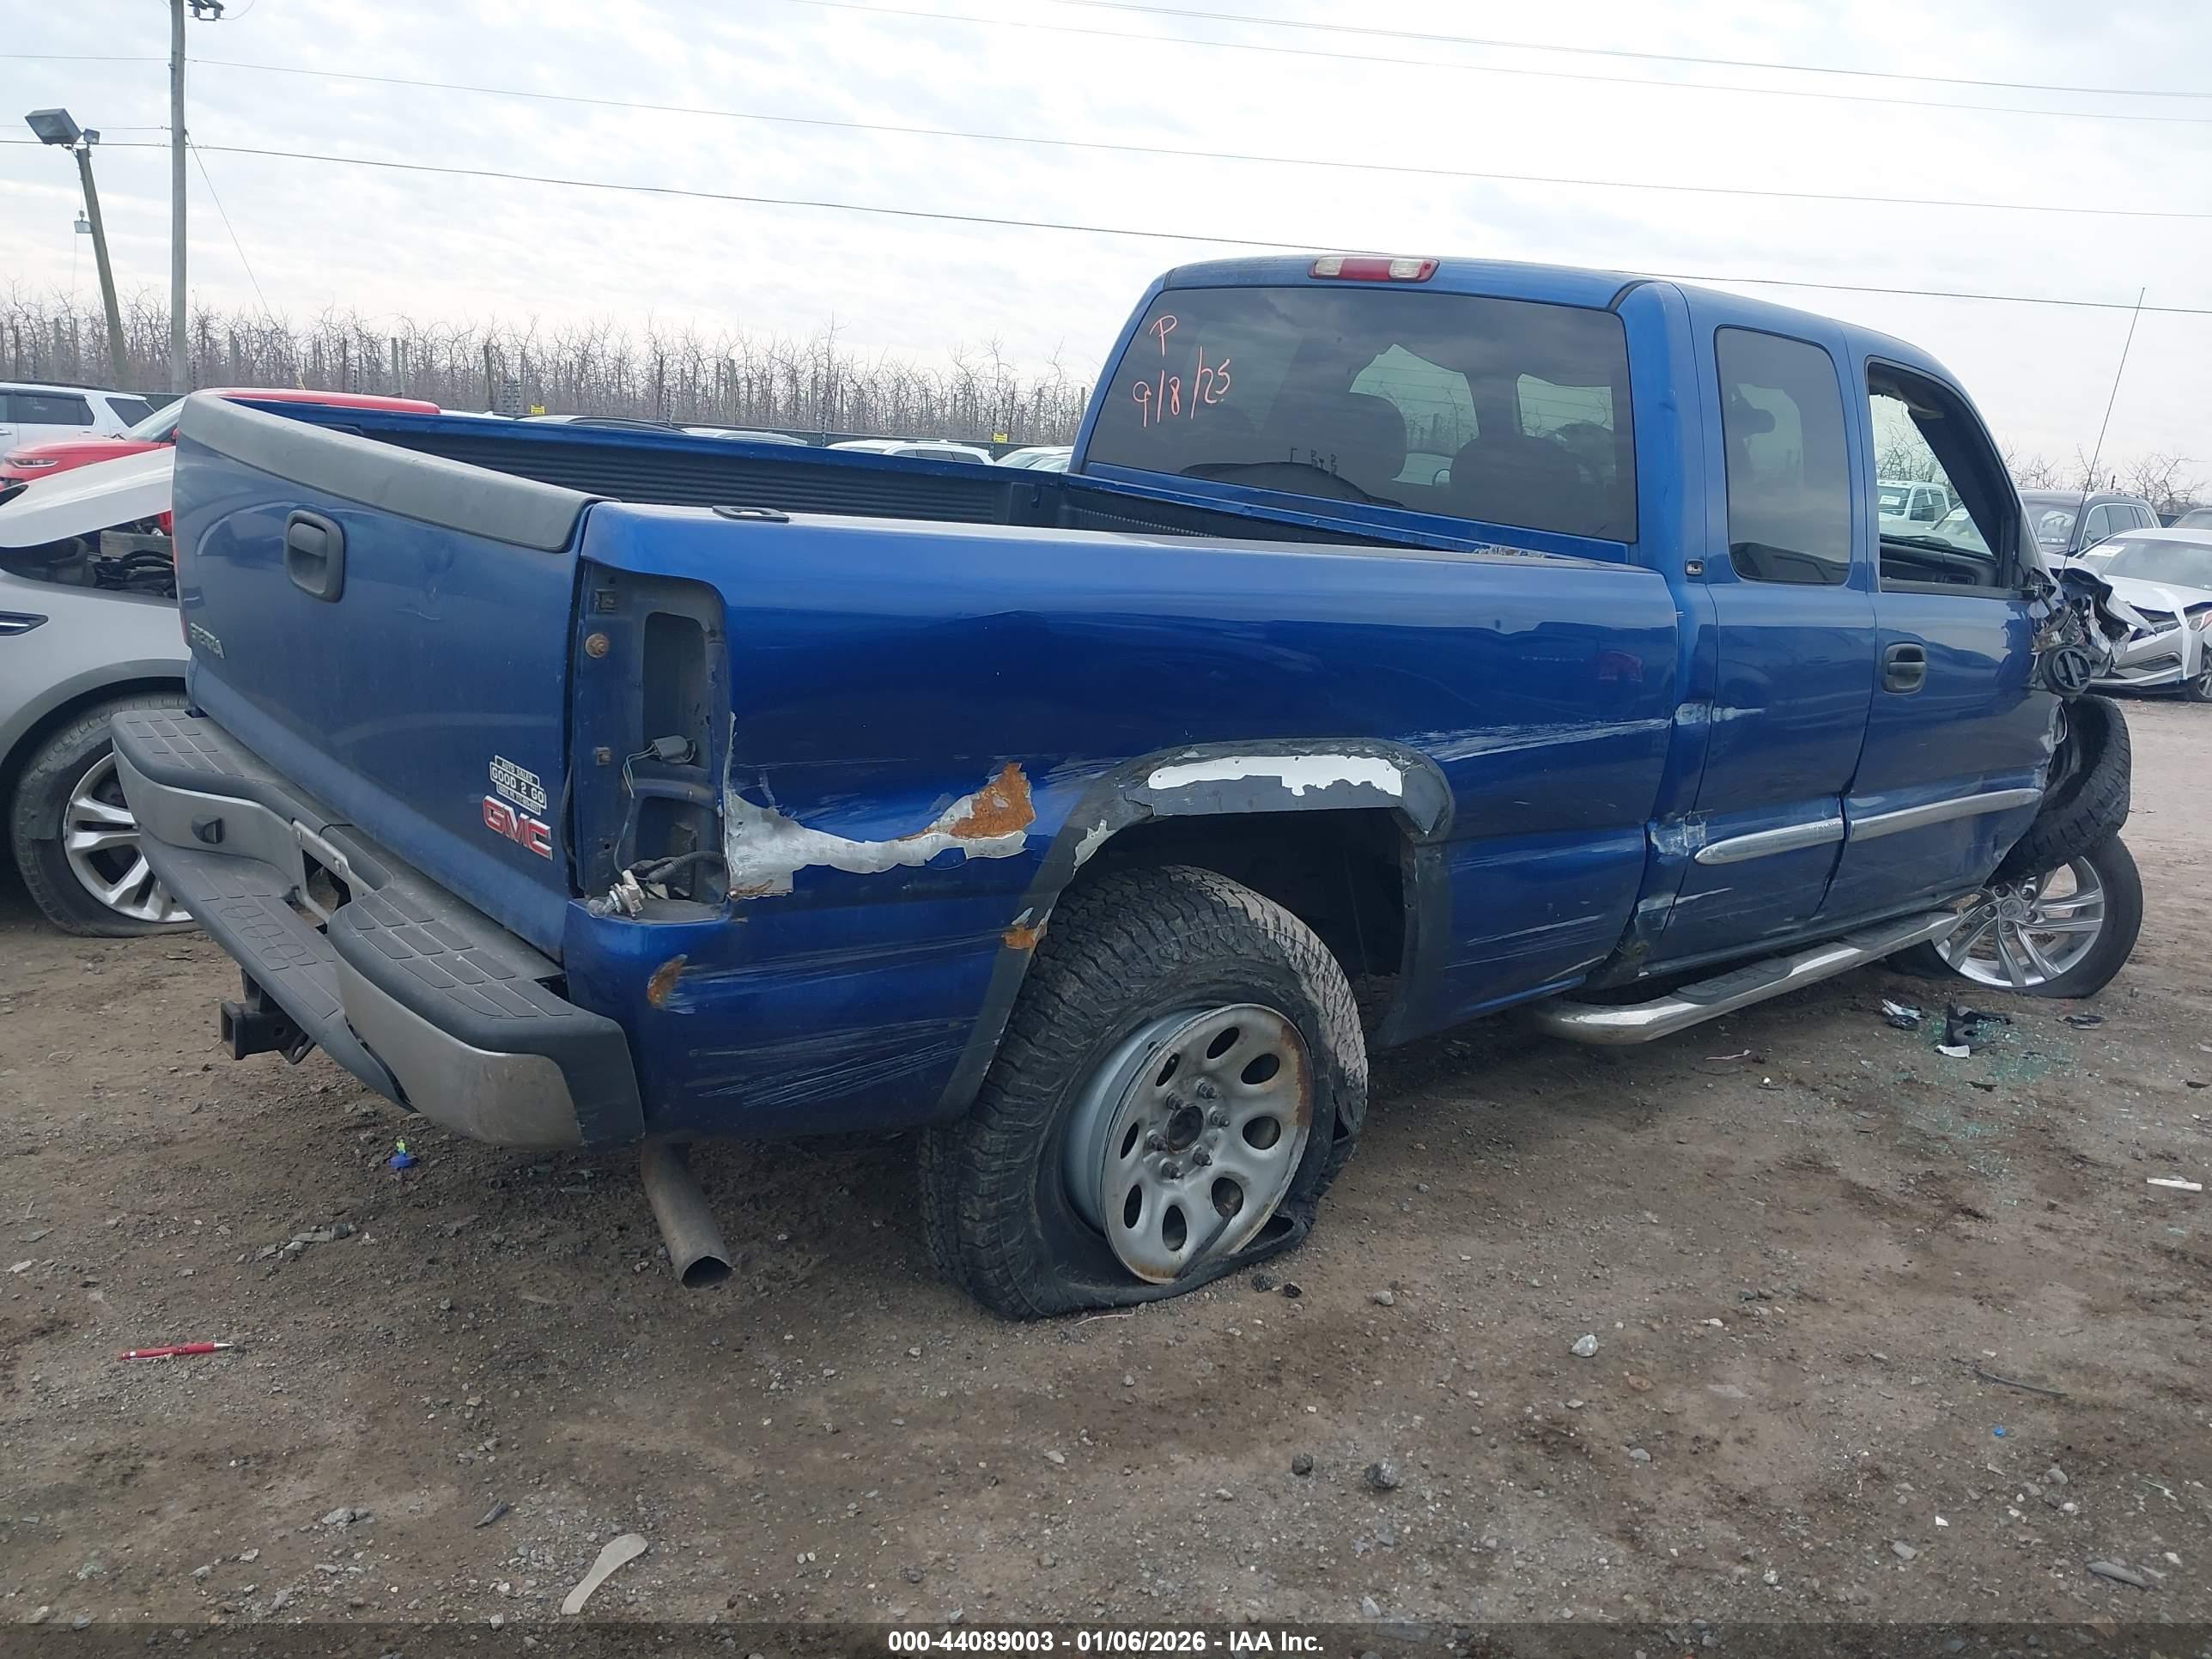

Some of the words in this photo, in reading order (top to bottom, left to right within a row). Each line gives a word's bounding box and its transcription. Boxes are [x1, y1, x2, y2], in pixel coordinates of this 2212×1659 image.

[1149, 314, 1178, 358] P
[492, 766, 517, 789] GOOD
[520, 781, 527, 795] 2
[531, 787, 544, 804] GO
[501, 760, 515, 773] AUTO
[516, 767, 533, 782] SALES
[483, 796, 553, 860] GMC
